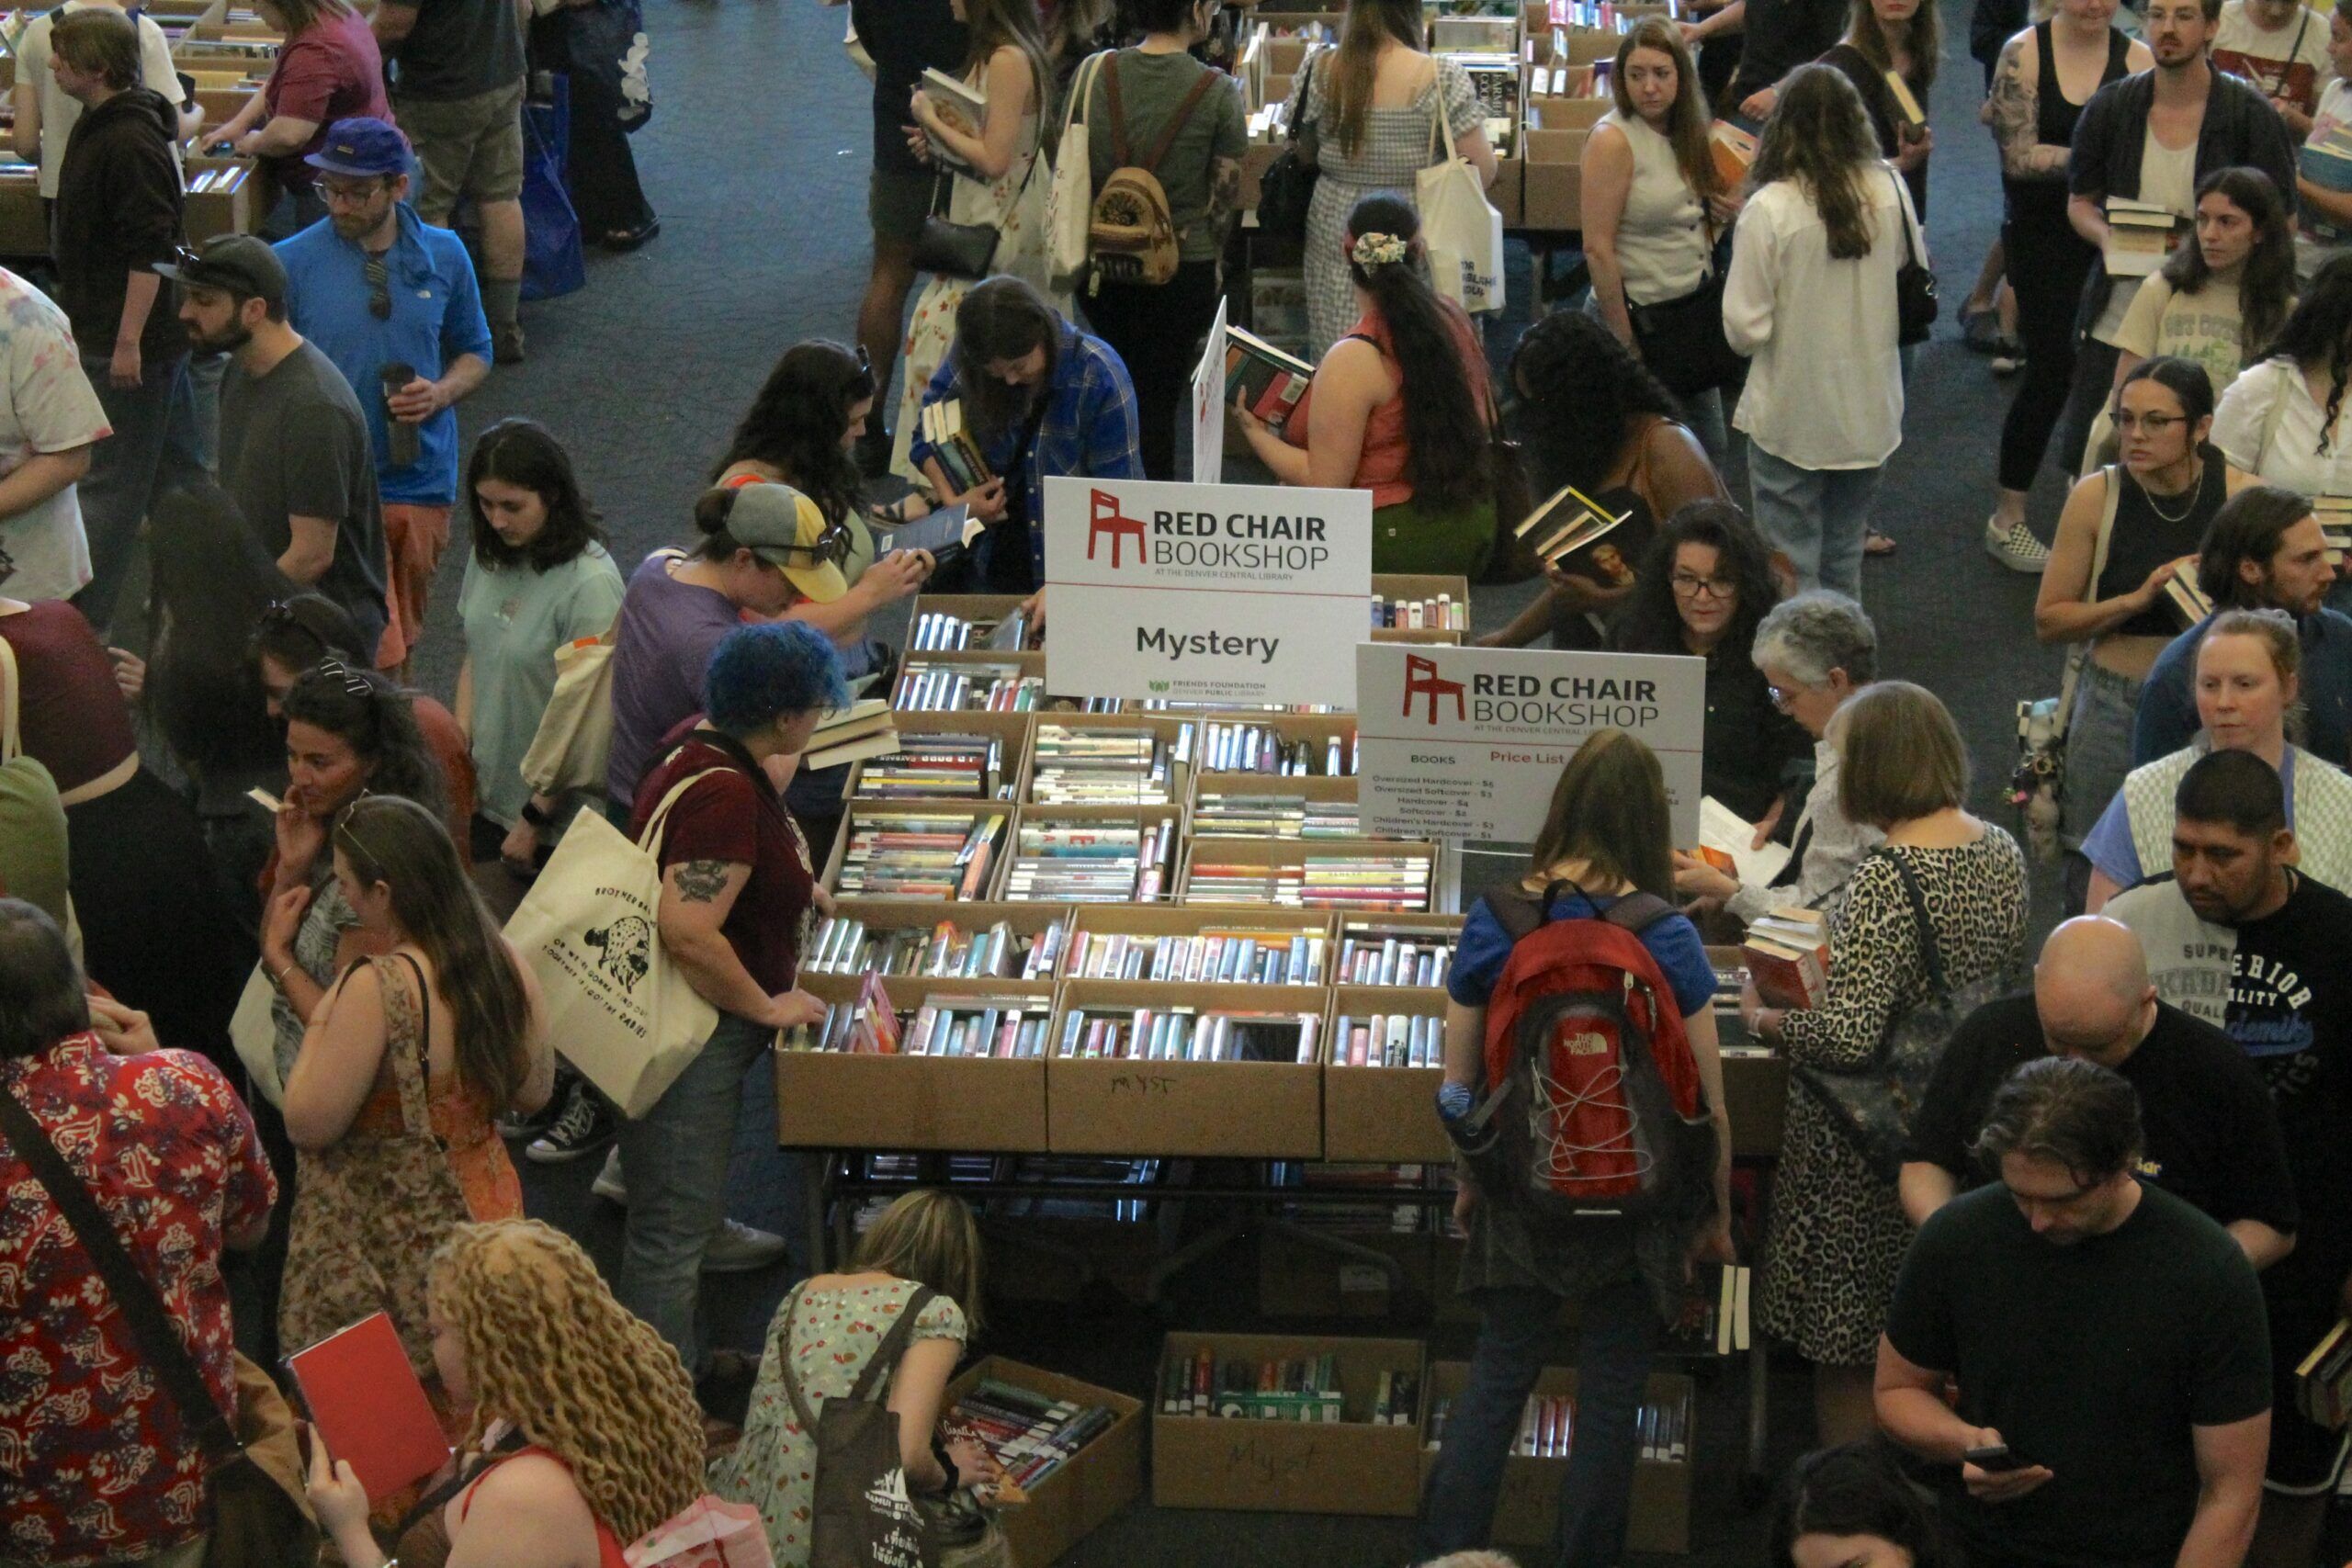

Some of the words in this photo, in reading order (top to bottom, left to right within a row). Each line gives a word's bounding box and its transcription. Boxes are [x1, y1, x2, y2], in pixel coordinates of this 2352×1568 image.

[1154, 511, 1217, 537] RED
[1226, 513, 1327, 541] CHAIR
[1154, 540, 1329, 570] BOOKSHOP
[1184, 570, 1218, 579] DENVER
[1220, 570, 1257, 581] CENTRAL
[1259, 572, 1294, 581] LIBRARY
[1136, 626, 1280, 664] Mystery
[1173, 680, 1208, 688] FRIENDS
[1209, 682, 1266, 690] FOUNDATION
[1474, 674, 1541, 697] RED
[1550, 677, 1657, 703] CHAIR
[1204, 689, 1233, 697] PUBLIC
[1234, 690, 1266, 698] LIBRARY
[1474, 700, 1659, 728] BOOKSHOP
[1505, 726, 1541, 734] DENVER
[1411, 754, 1456, 765] BOOKS
[1490, 750, 1532, 763] Price
[1536, 753, 1565, 765] List
[1422, 777, 1473, 787] Hardcover
[1424, 787, 1472, 797] Softcover
[1397, 797, 1448, 807] Hardcover
[1399, 807, 1446, 817] Softcover
[1422, 818, 1473, 828] Hardcover
[1425, 828, 1472, 838] Softcover
[618, 1011, 647, 1039] RABIES
